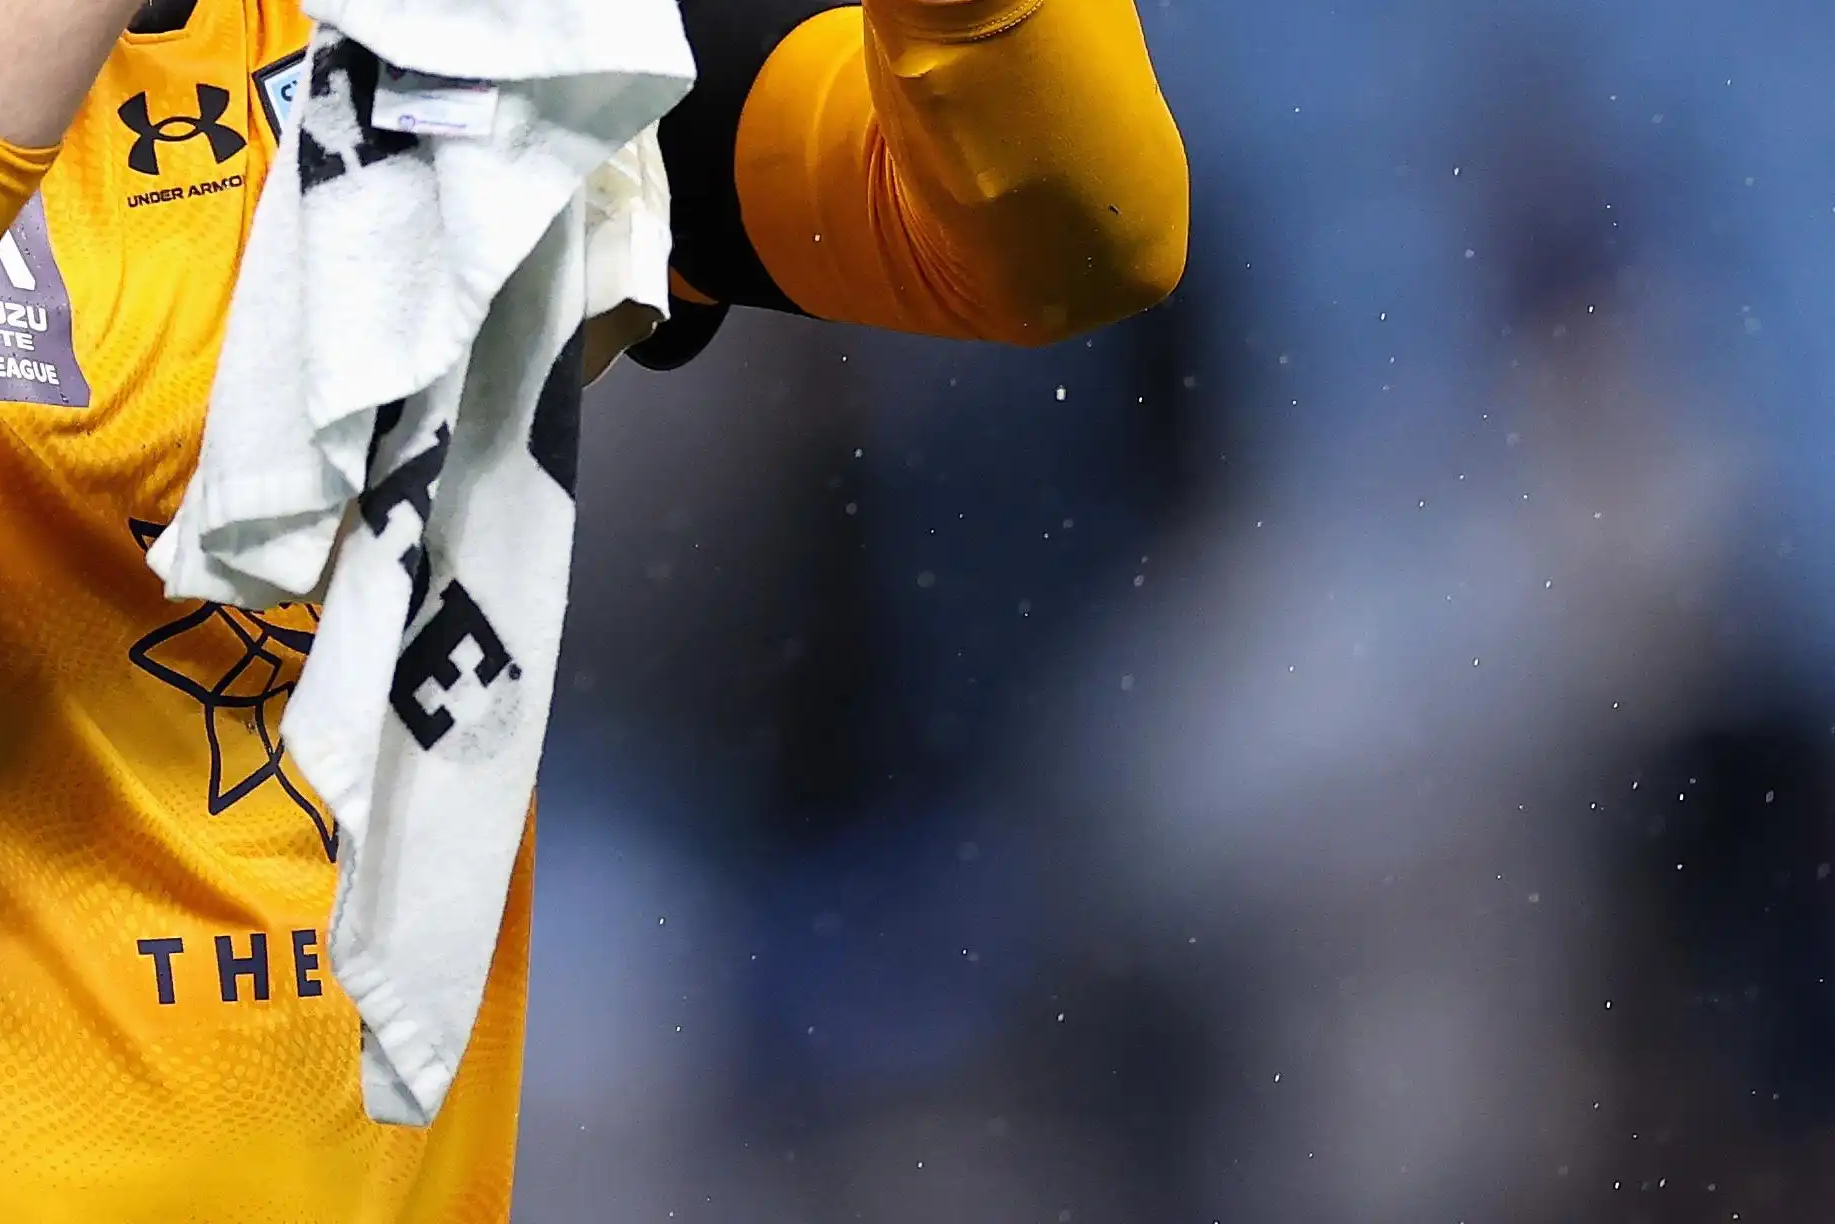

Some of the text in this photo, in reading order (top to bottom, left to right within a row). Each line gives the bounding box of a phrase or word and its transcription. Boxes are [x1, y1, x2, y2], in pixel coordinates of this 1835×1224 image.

[127, 174, 244, 208] UNDER ARMO
[137, 929, 322, 1004] THE
